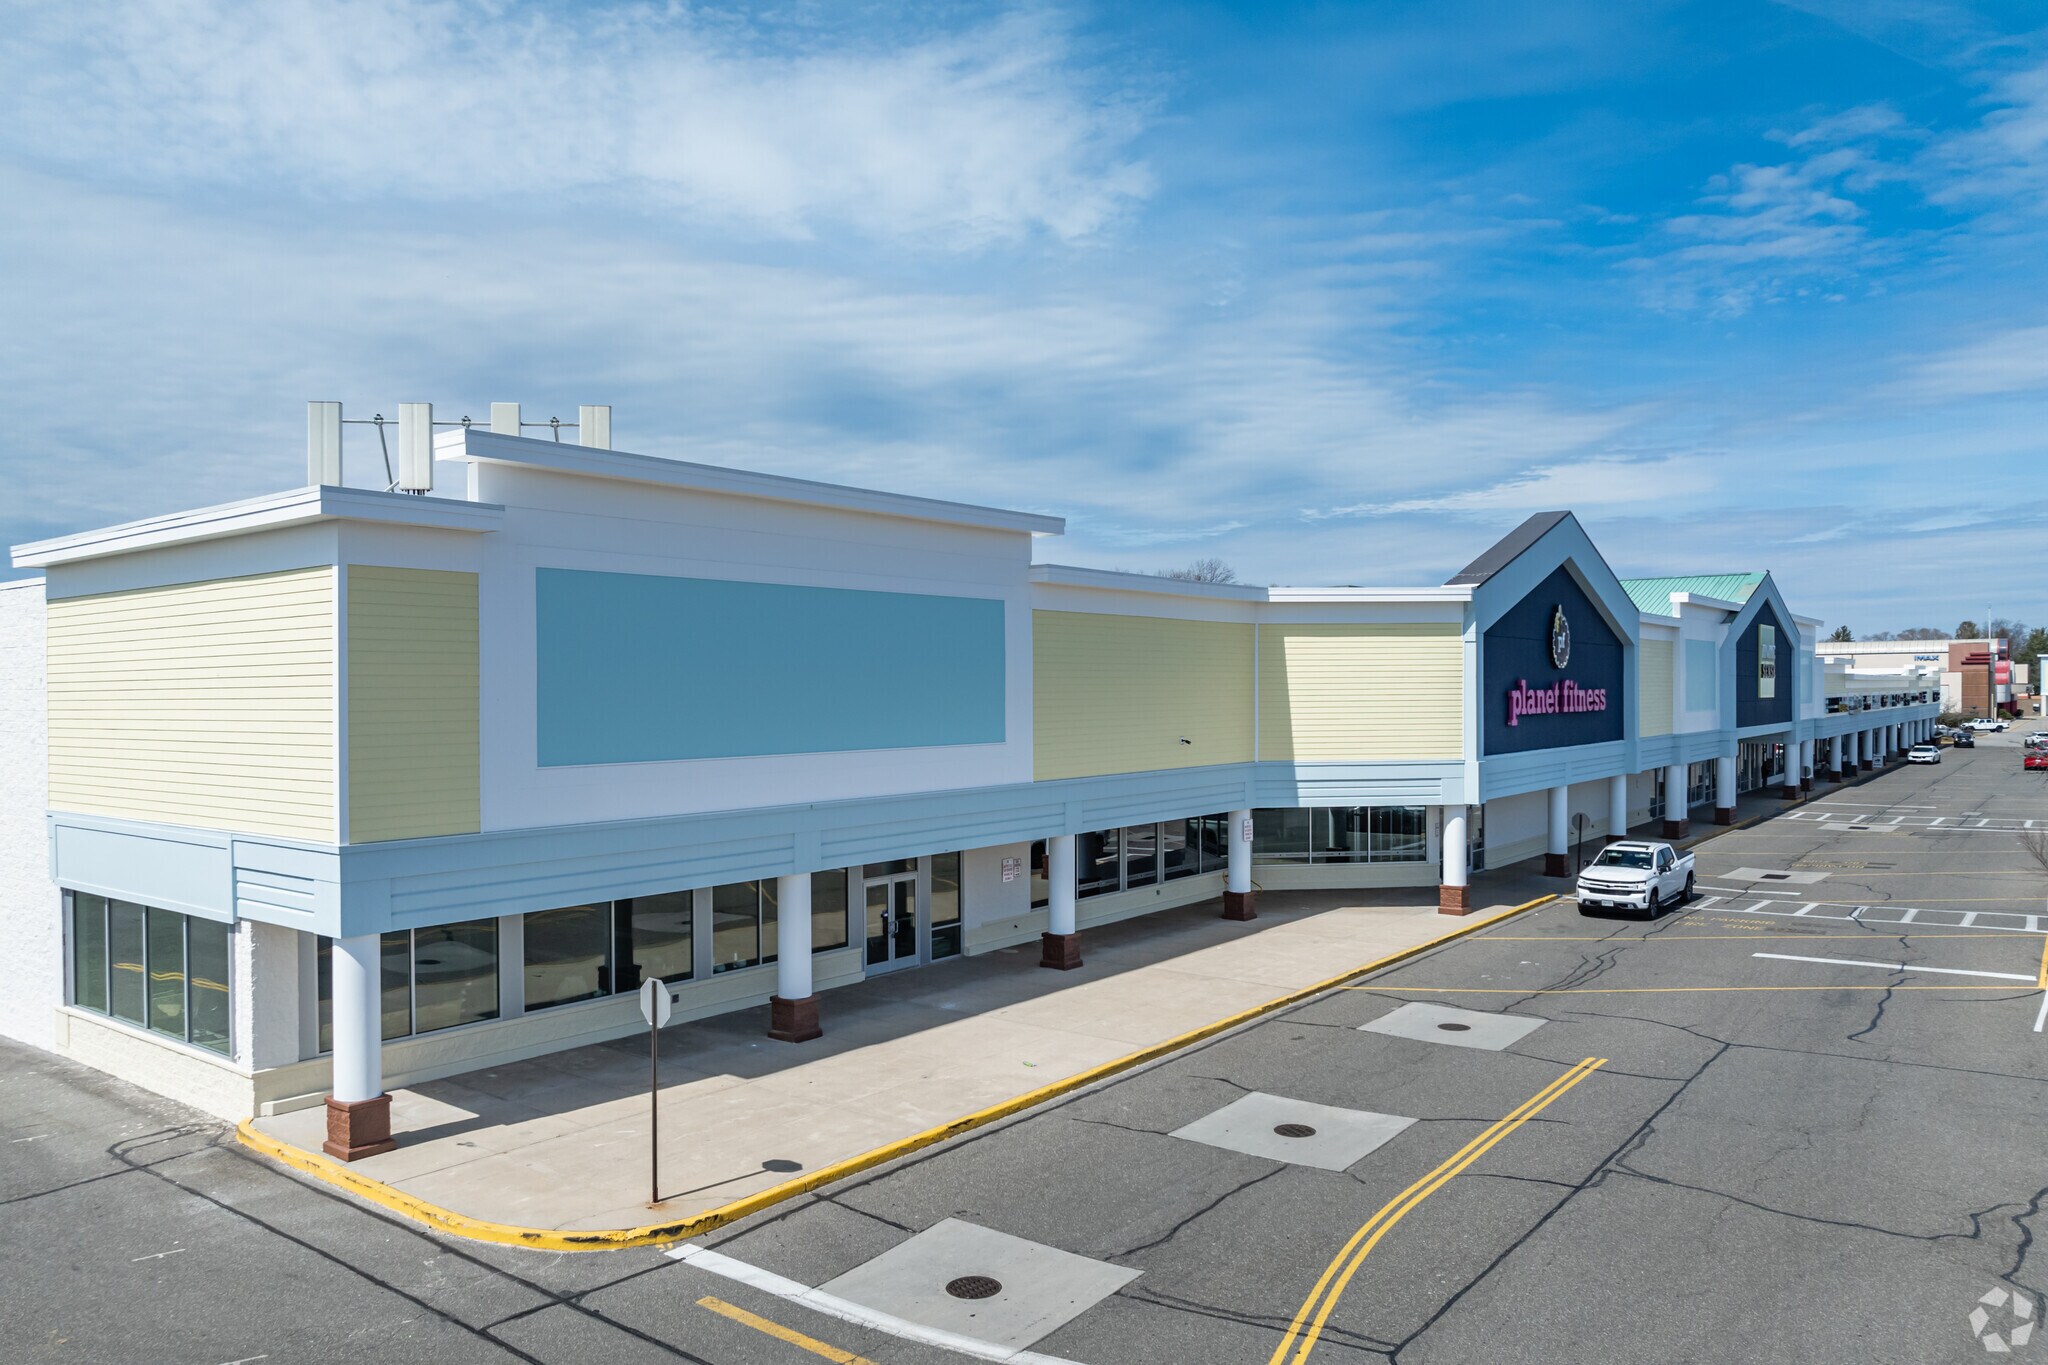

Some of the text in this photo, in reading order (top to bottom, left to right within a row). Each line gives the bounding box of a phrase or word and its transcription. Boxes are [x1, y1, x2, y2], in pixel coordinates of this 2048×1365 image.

[1510, 680, 1606, 726] planet fitness
[1710, 917, 1776, 925] PARKING
